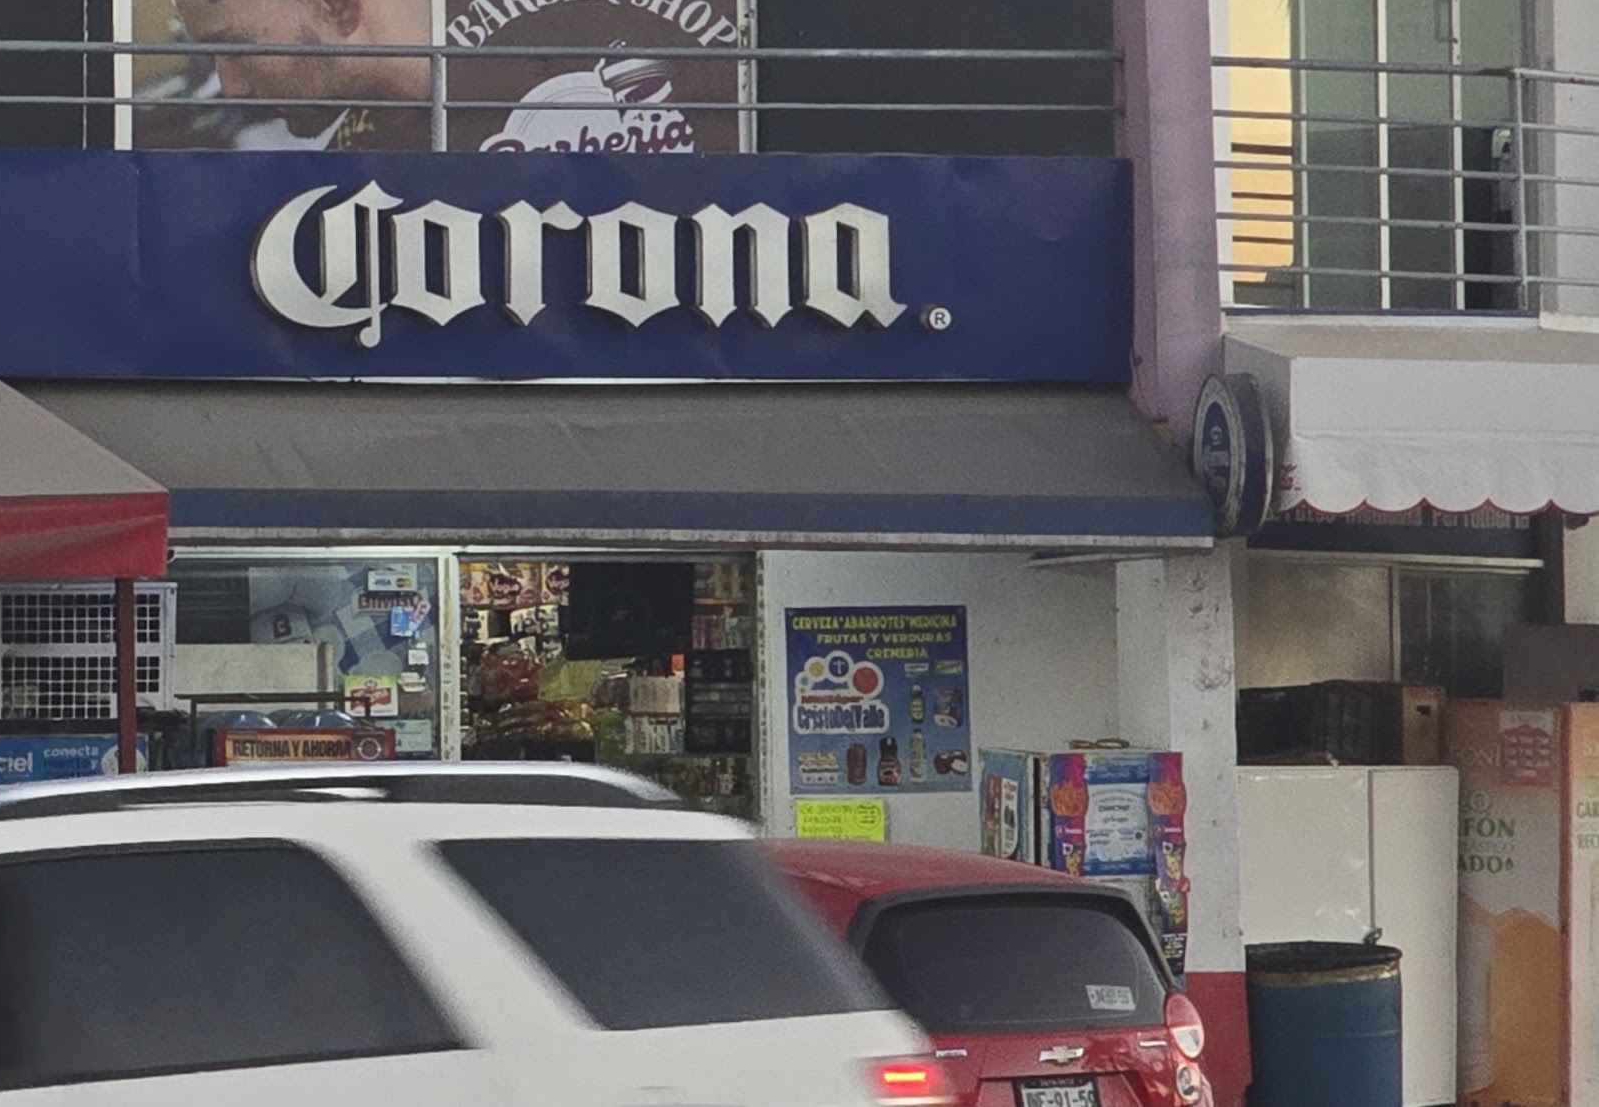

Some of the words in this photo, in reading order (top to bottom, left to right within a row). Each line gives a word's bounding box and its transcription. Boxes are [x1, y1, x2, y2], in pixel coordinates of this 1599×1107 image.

[250, 179, 909, 349] Corona
[817, 634, 867, 645] FRUTAS
[883, 632, 953, 644] VERDURAS
[43, 746, 99, 758] conecta
[232, 739, 290, 758] RETORNA
